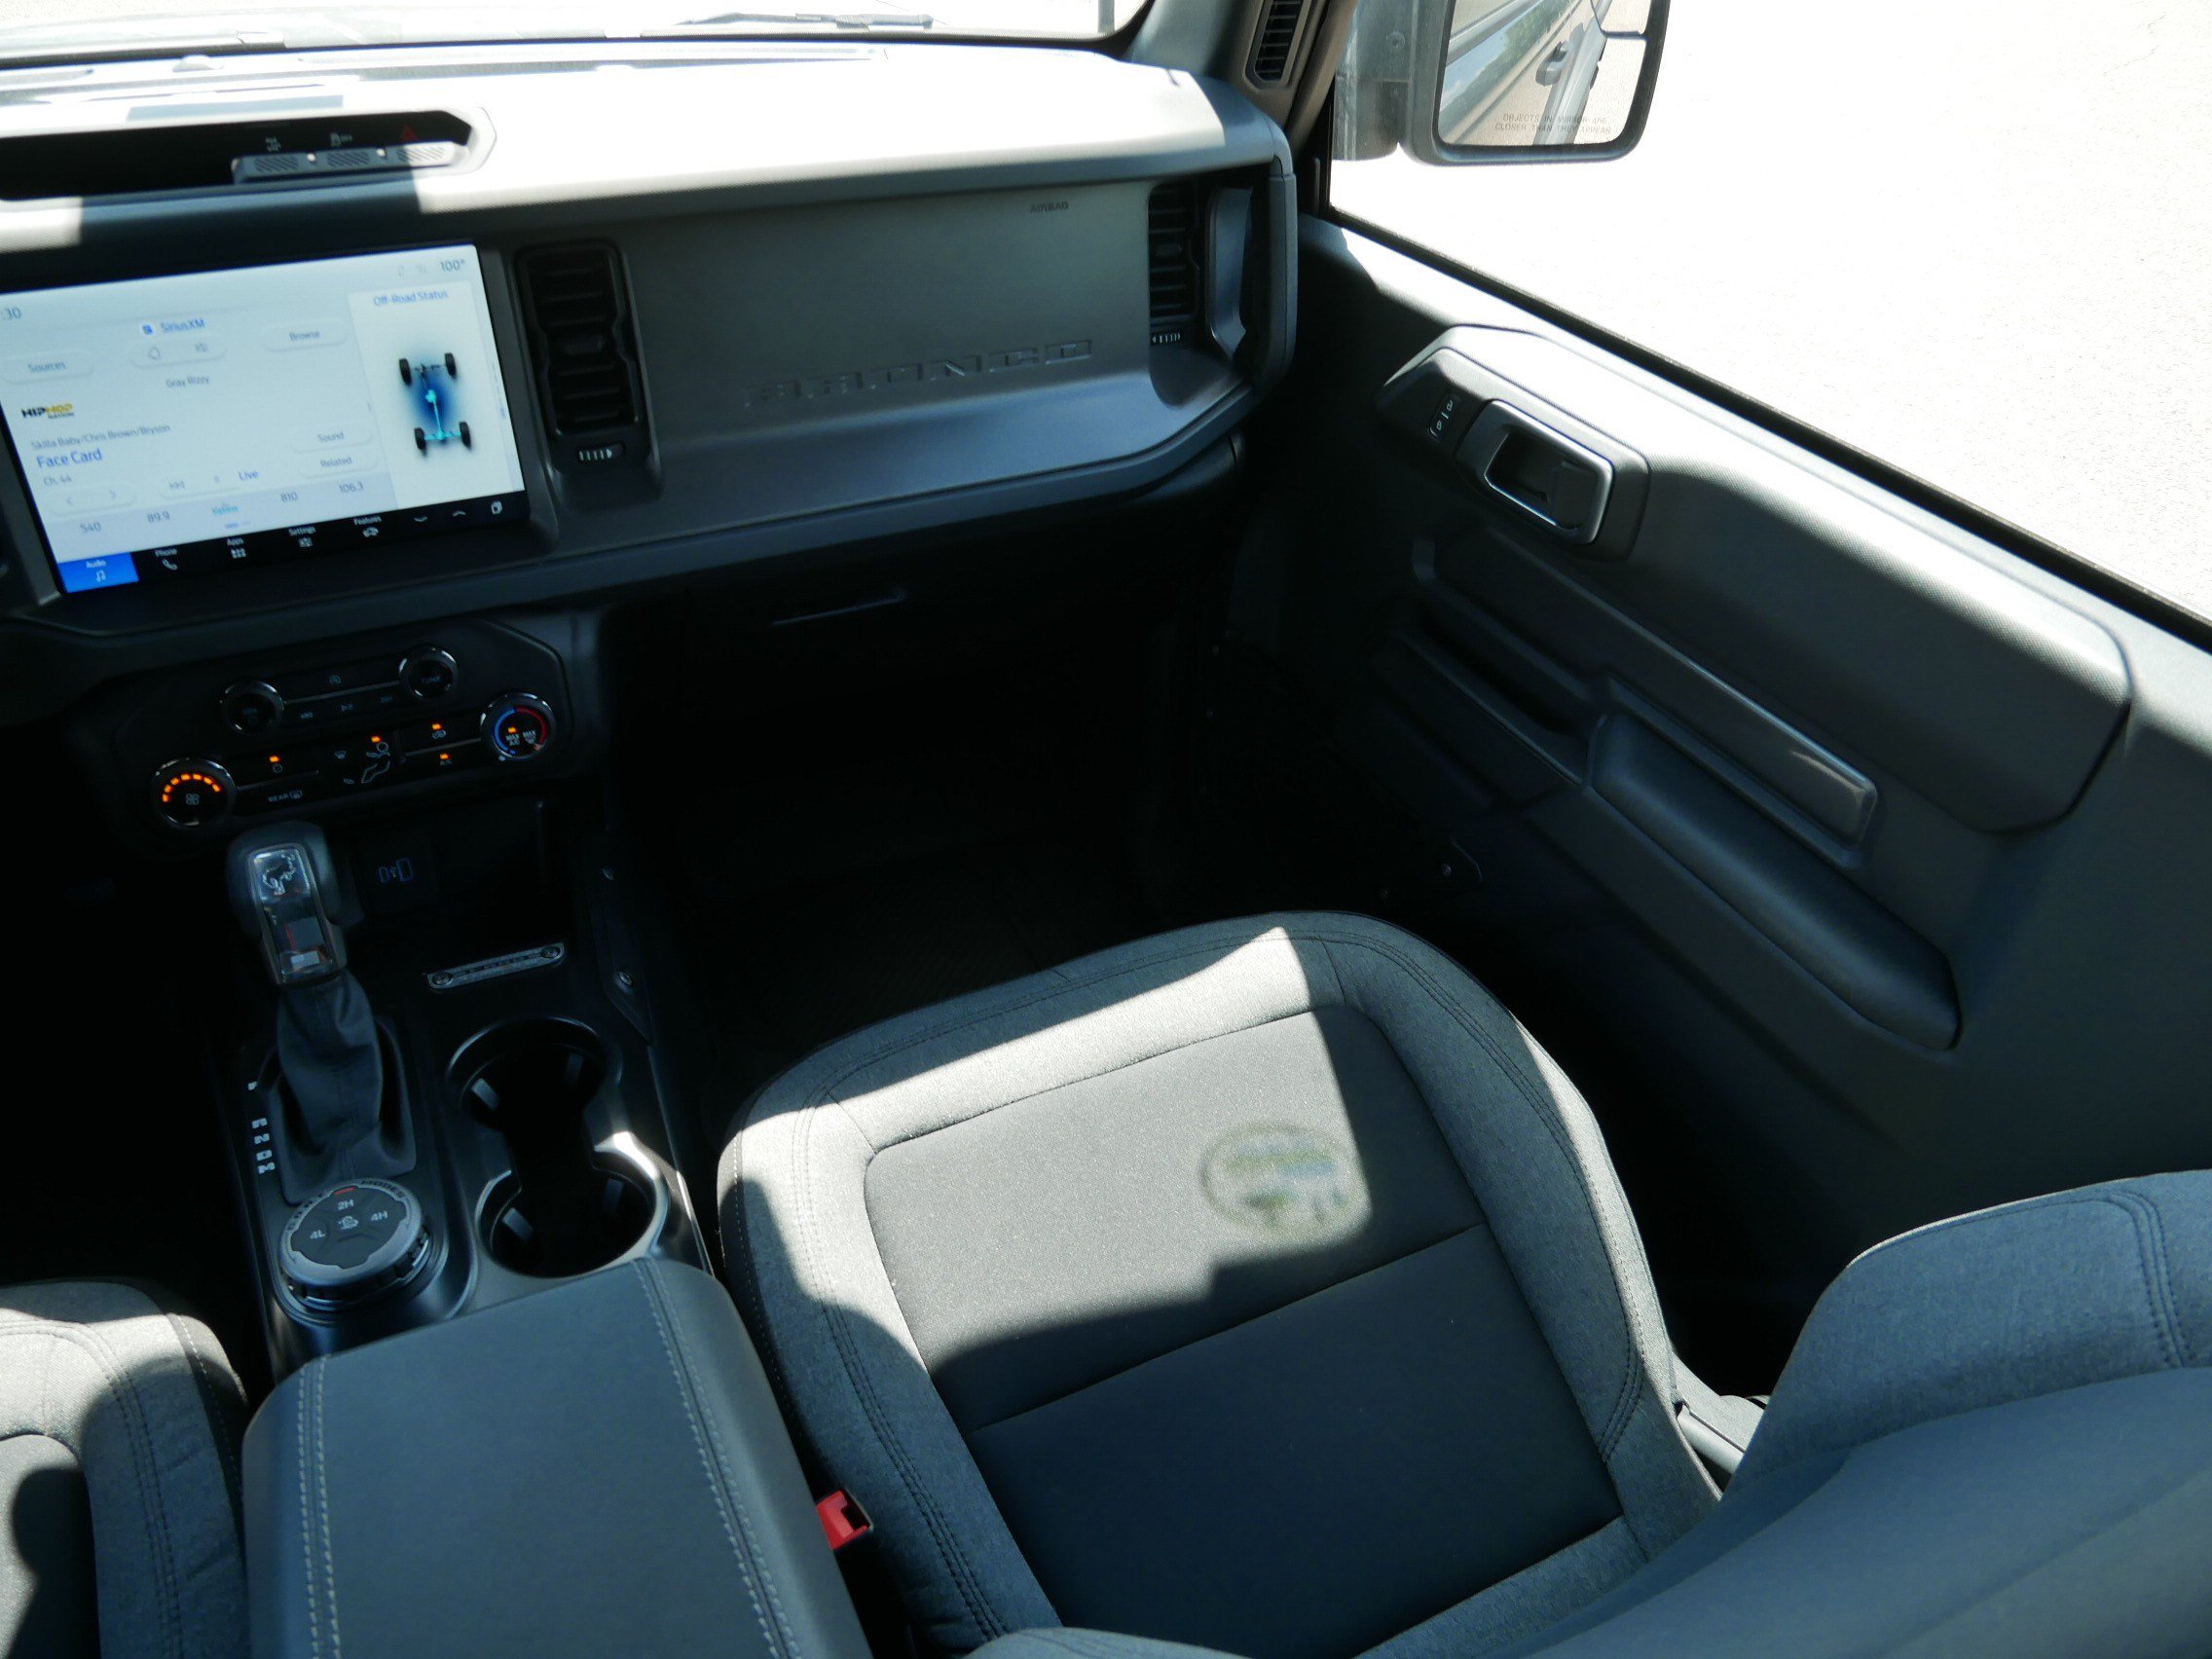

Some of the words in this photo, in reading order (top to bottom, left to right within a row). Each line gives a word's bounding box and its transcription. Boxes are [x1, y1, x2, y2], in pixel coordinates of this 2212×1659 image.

[373, 294, 417, 307] Off-Road
[419, 290, 449, 303] Status
[160, 316, 206, 334] SiriusXM
[27, 359, 66, 373] Sources
[37, 454, 68, 468] Face
[71, 448, 102, 464] Card
[238, 470, 259, 482] Live
[337, 1198, 355, 1210] 2H
[371, 1210, 388, 1222] 4H
[310, 1229, 326, 1240] 4L
